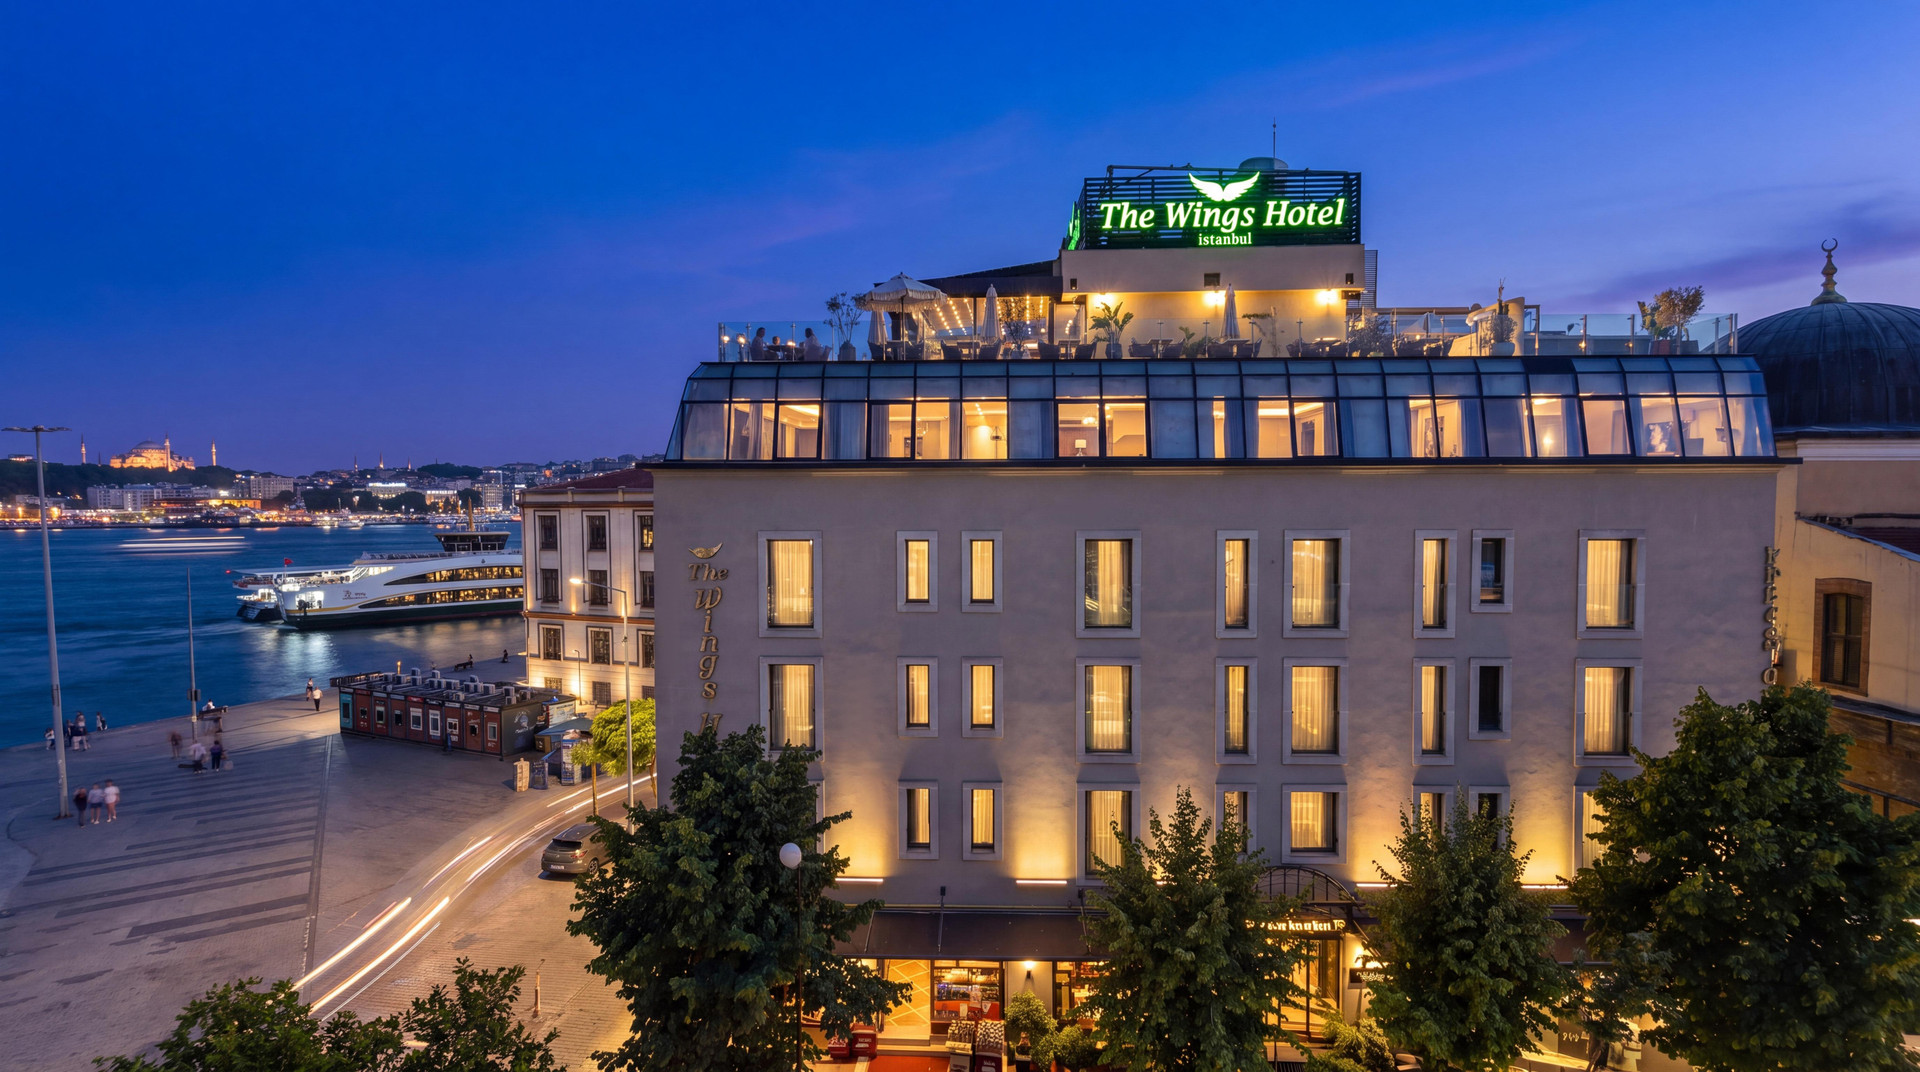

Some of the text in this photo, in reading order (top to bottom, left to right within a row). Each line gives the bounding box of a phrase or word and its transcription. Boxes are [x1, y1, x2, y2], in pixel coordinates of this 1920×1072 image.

[1100, 202, 1155, 229] The
[1166, 201, 1255, 233] Wings
[1263, 198, 1345, 227] Hotel
[1198, 233, 1252, 246] istanbul
[688, 563, 728, 581] The
